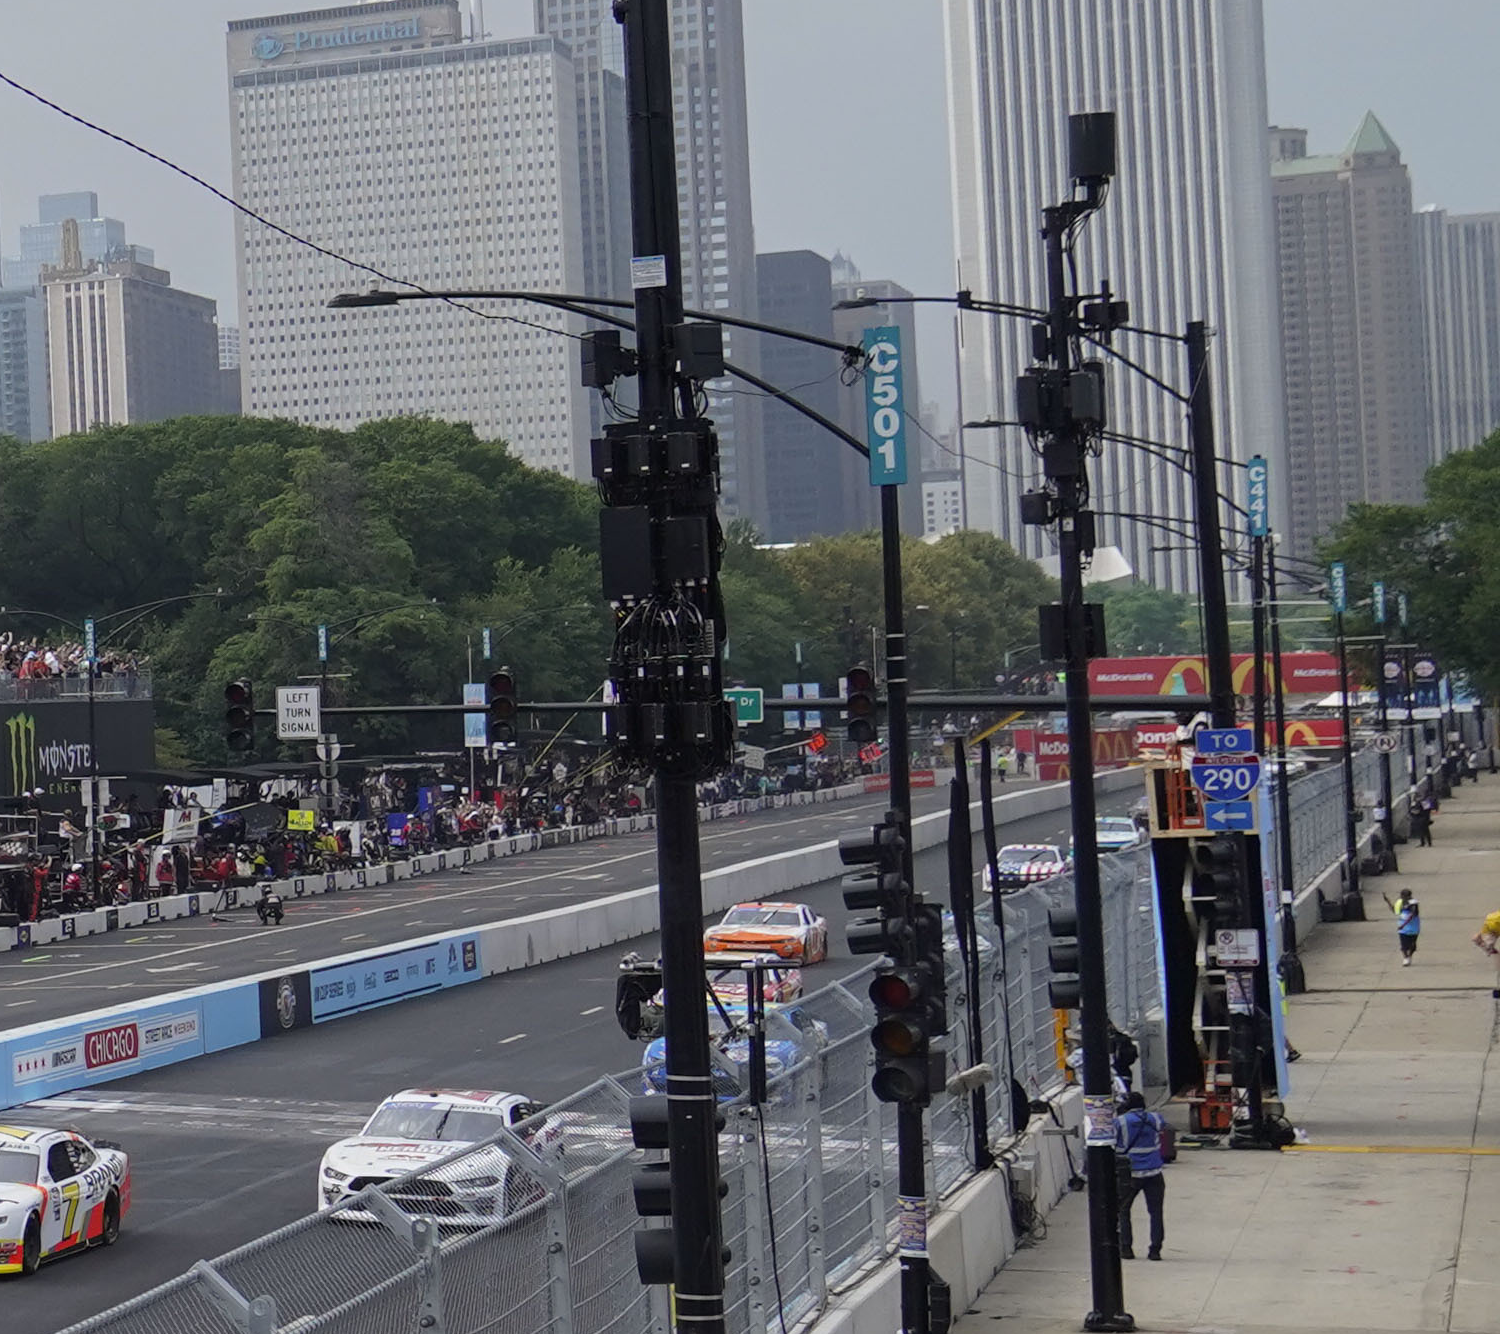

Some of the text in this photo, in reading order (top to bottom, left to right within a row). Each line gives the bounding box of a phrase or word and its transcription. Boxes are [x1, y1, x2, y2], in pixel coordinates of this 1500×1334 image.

[867, 341, 900, 470] C501
[1249, 466, 1266, 529] C441
[286, 693, 309, 703] LEFT
[740, 696, 754, 707] Dr
[281, 722, 317, 733] SIGNAL
[285, 708, 311, 718] TURN
[1211, 734, 1239, 749] TO
[39, 740, 95, 775] MONSTE
[1202, 768, 1251, 792] 290
[88, 1027, 135, 1067] CHICAGO
[144, 1027, 160, 1045] STREET
[160, 1025, 173, 1041] RACE
[173, 1019, 196, 1038] WEEKEND
[85, 1153, 125, 1199] BRANDT
[61, 1182, 81, 1242] 7
